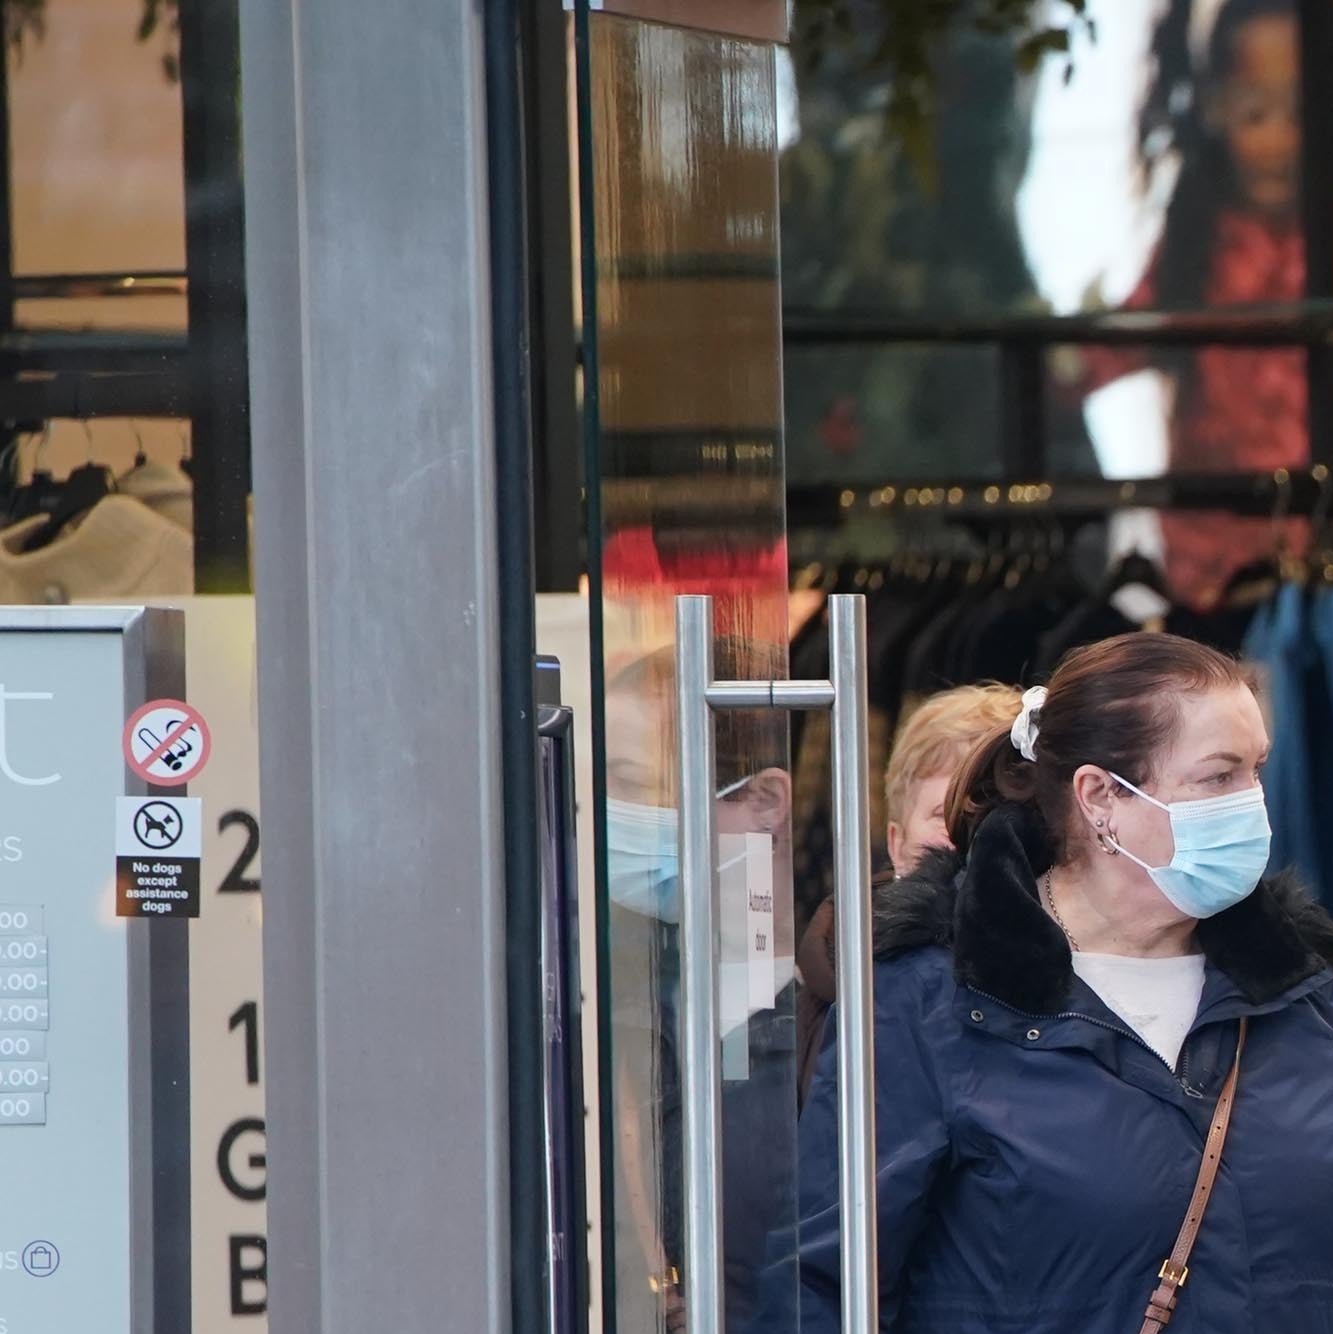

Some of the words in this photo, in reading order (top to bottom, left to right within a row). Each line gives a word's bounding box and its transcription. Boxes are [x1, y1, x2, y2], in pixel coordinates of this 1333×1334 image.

[132, 862, 149, 873] No
[152, 862, 182, 875] dogs
[216, 808, 260, 894] 2
[126, 888, 189, 899] assistance
[137, 876, 177, 888] except
[142, 901, 172, 913] dogs
[227, 1001, 259, 1085] 1
[217, 1117, 266, 1202] G
[229, 1234, 267, 1316] B
